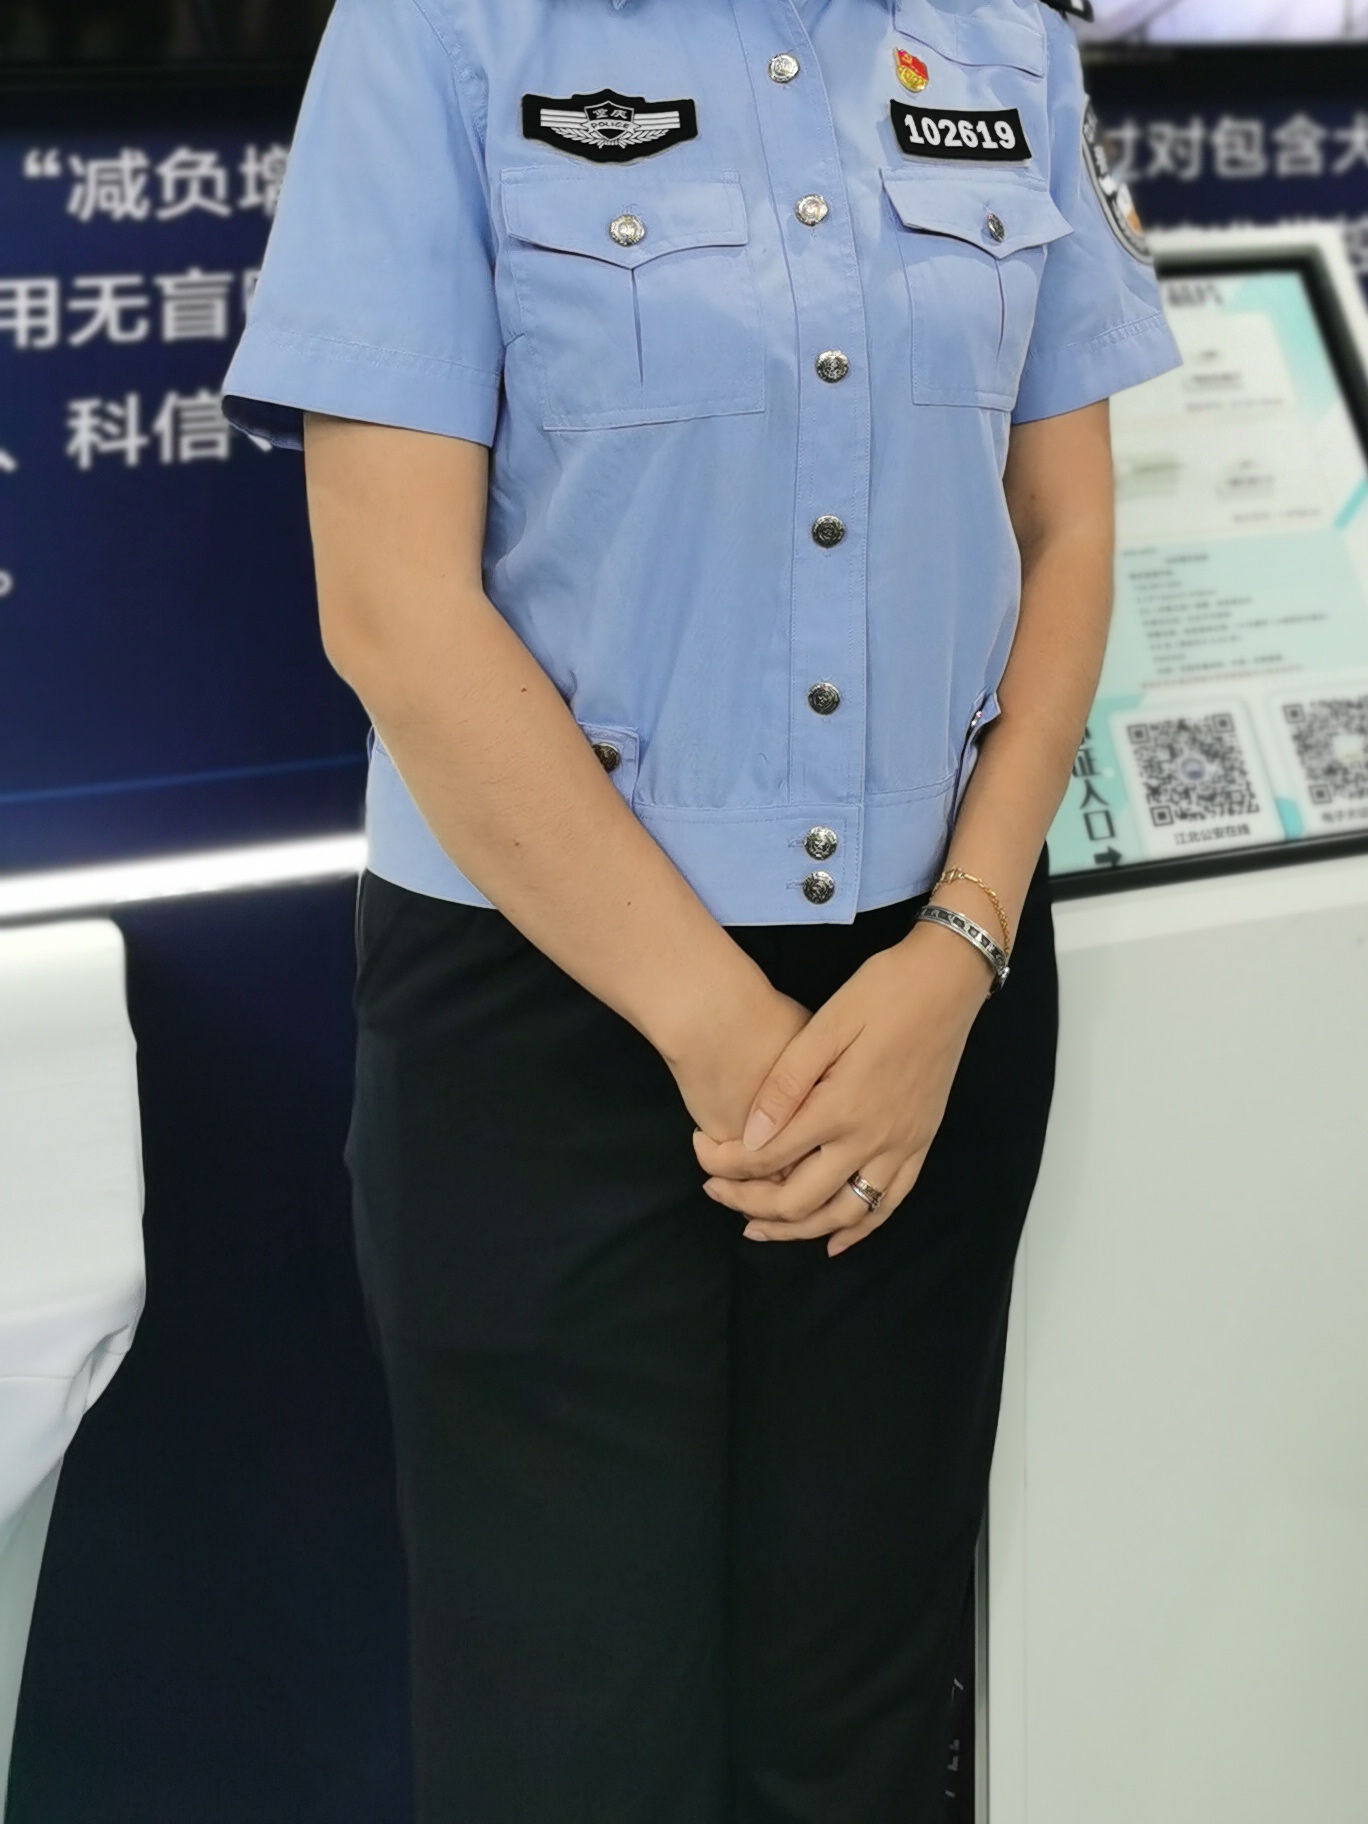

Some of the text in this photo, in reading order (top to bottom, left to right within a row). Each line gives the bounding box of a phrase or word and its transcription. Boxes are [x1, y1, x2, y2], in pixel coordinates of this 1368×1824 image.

[590, 120, 631, 129] POLICE
[592, 107, 628, 119] 重庆
[904, 114, 1016, 150] 102619
[0, 267, 258, 349] 用无盲
[1071, 725, 1115, 841] 证入口
[1174, 823, 1251, 846] 江北公安在线
